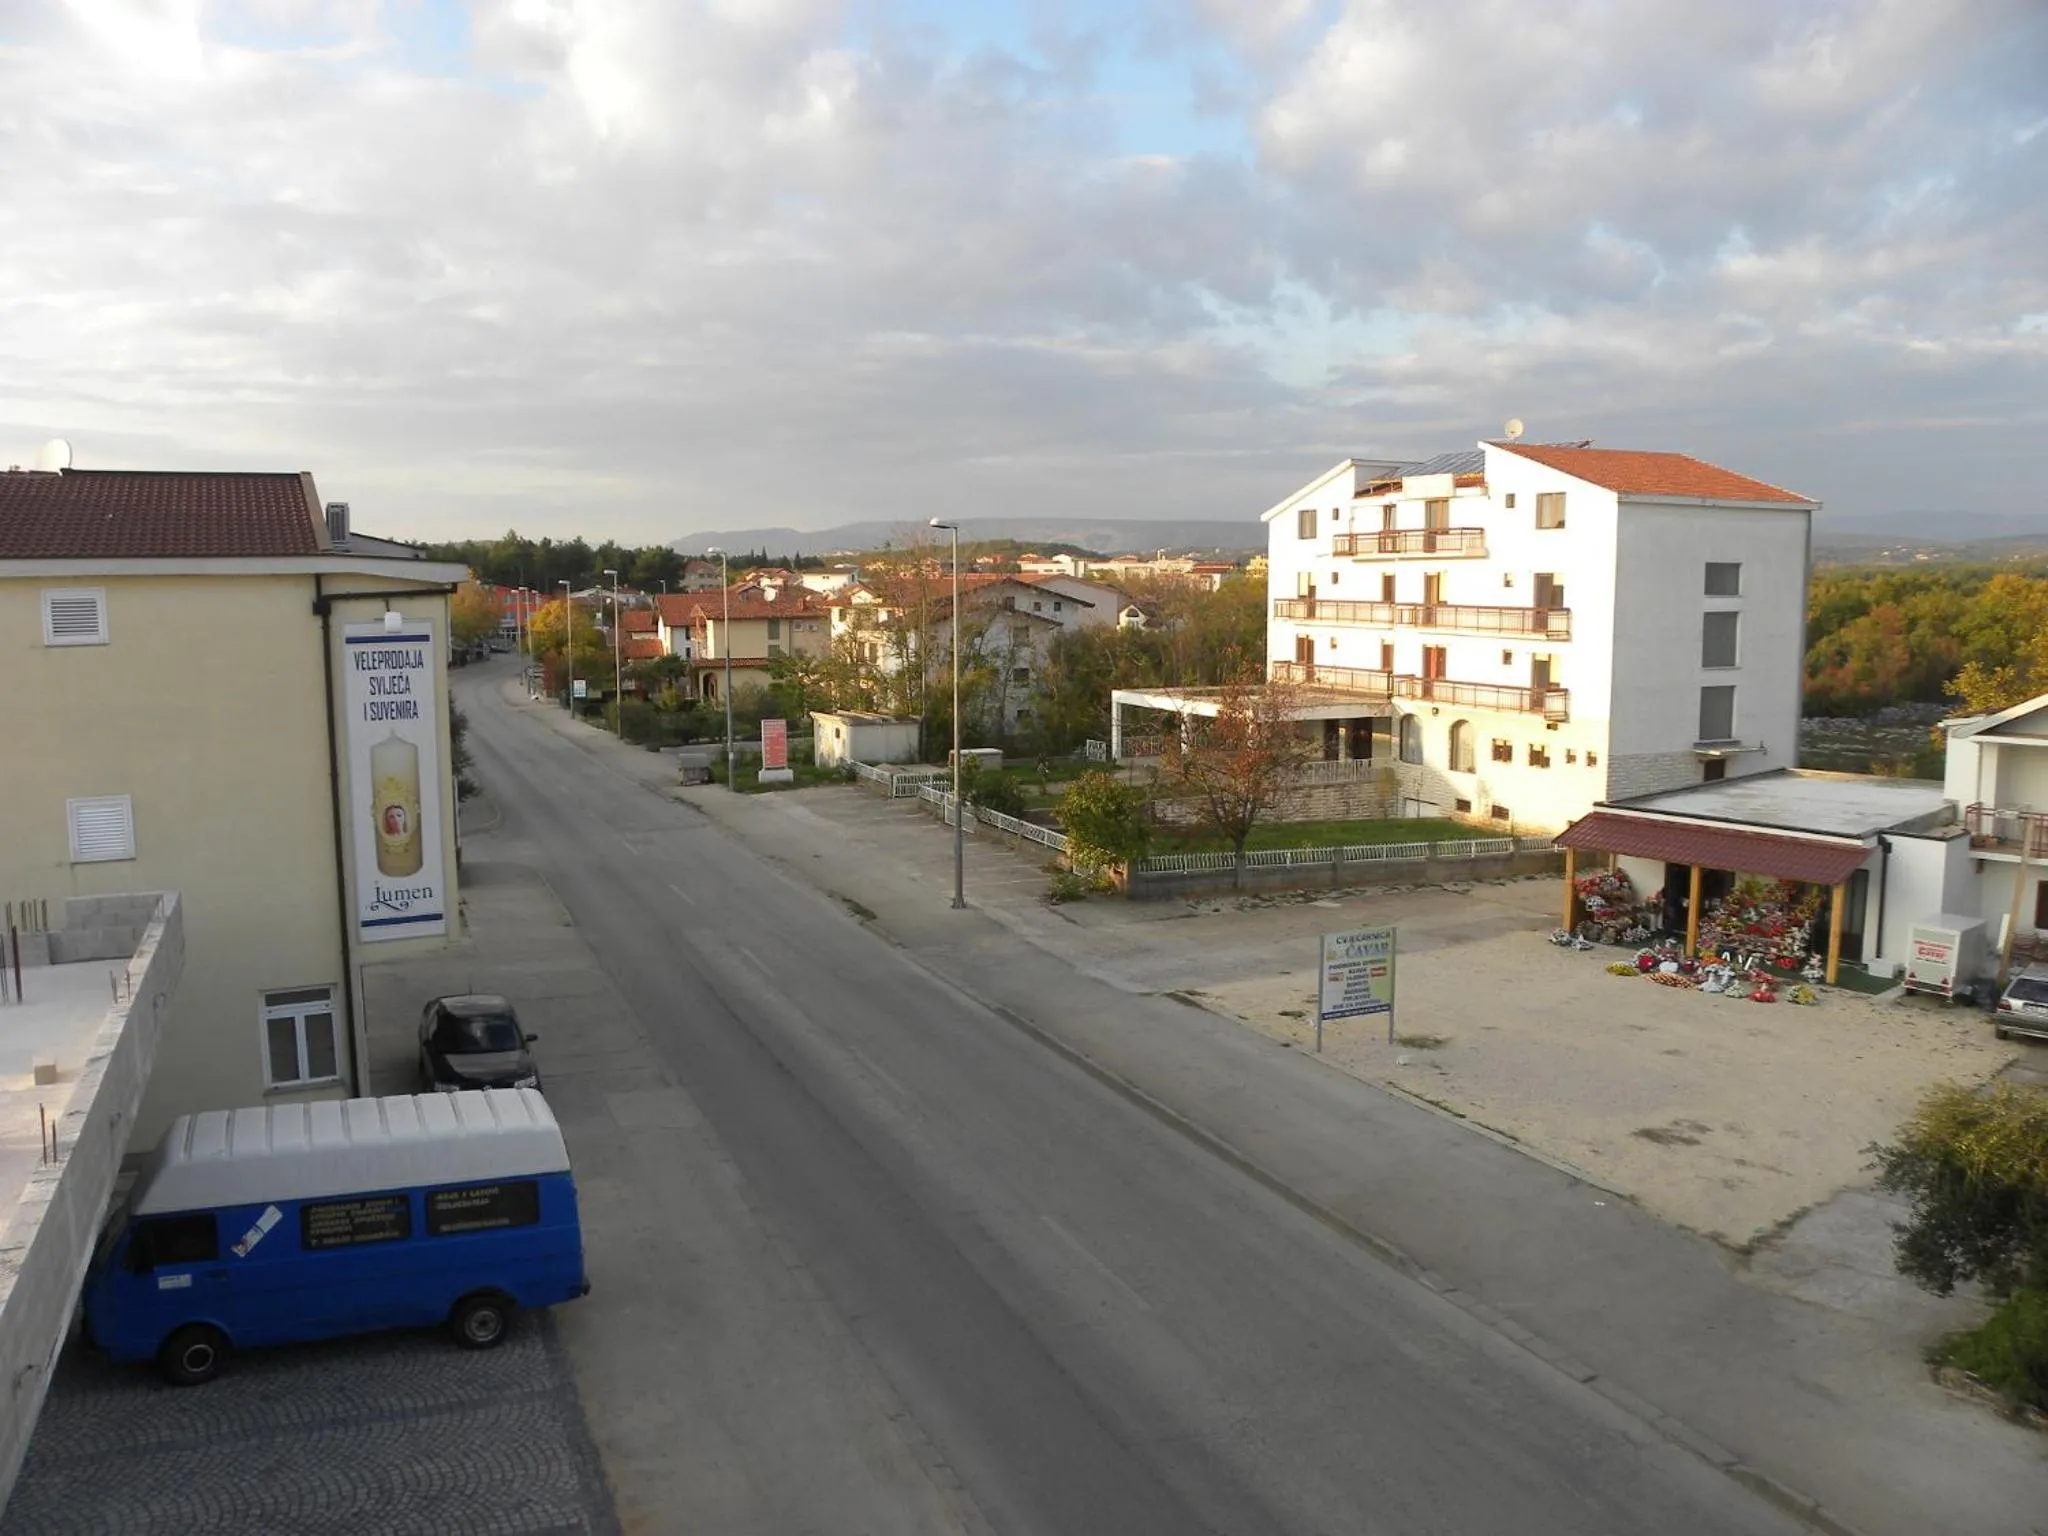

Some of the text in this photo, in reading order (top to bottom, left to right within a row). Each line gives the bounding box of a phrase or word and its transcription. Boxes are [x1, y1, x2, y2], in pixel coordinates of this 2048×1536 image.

[353, 649, 424, 670] VELEPRODAJA
[369, 672, 411, 695] SVIJEĆA
[364, 700, 419, 721] I SUVENIRA
